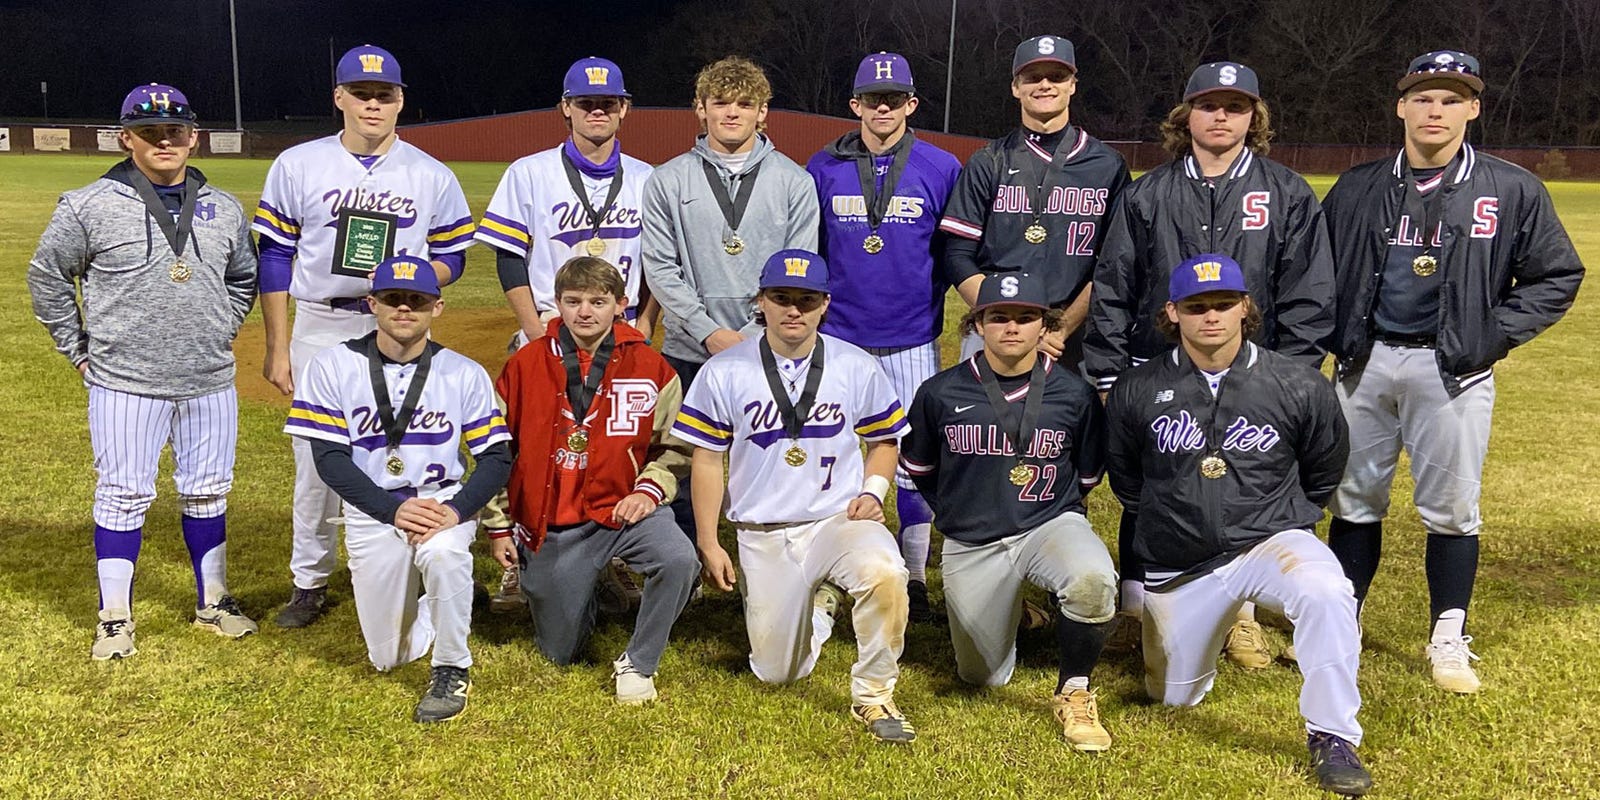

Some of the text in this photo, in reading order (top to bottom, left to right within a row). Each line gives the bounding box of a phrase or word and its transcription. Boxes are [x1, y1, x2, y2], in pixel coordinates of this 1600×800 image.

[1038, 38, 1056, 55] S
[359, 54, 385, 73] W
[584, 67, 609, 85] W
[875, 61, 893, 80] H
[1219, 66, 1237, 86] S
[149, 92, 170, 111] H
[194, 201, 217, 221] H
[323, 187, 417, 217] Wister
[832, 195, 925, 218] WOES
[993, 185, 1109, 216] BULDOGS
[1242, 191, 1270, 230] S
[552, 202, 643, 231] Wter
[838, 216, 916, 224] BASBALL
[1470, 197, 1499, 239] S
[1066, 221, 1096, 256] 12
[391, 262, 418, 280] W
[619, 255, 632, 287] 3
[784, 257, 810, 278] W
[1193, 262, 1221, 282] W
[1000, 276, 1019, 297] S
[351, 405, 454, 436] Wter
[607, 379, 659, 436] P
[743, 400, 846, 432] Wer
[1151, 410, 1280, 453] Wister
[821, 456, 837, 491] 7
[1018, 465, 1057, 501] 22
